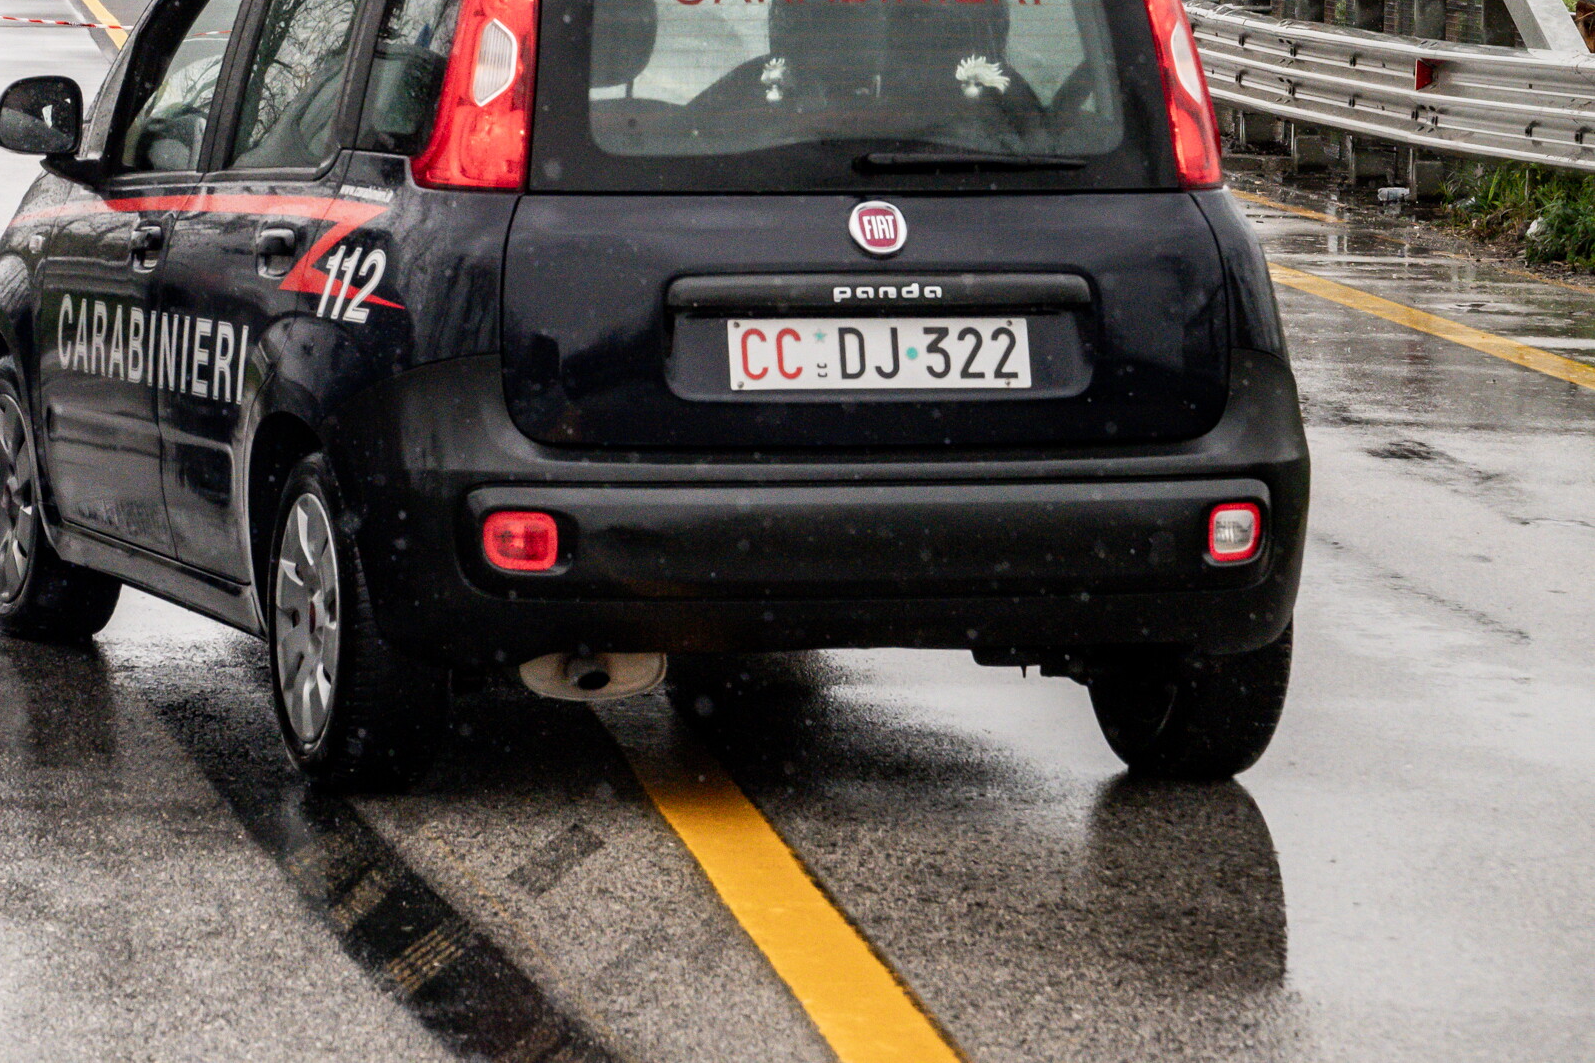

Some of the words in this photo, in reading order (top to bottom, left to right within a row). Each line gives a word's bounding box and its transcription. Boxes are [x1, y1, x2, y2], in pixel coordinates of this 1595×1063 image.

[862, 215, 896, 240] FIAT
[316, 245, 387, 324] 112
[833, 283, 943, 302] panda
[58, 293, 250, 406] CARABINIERI
[741, 327, 803, 380] CC
[838, 326, 901, 380] DJ
[922, 326, 1019, 379] 322
